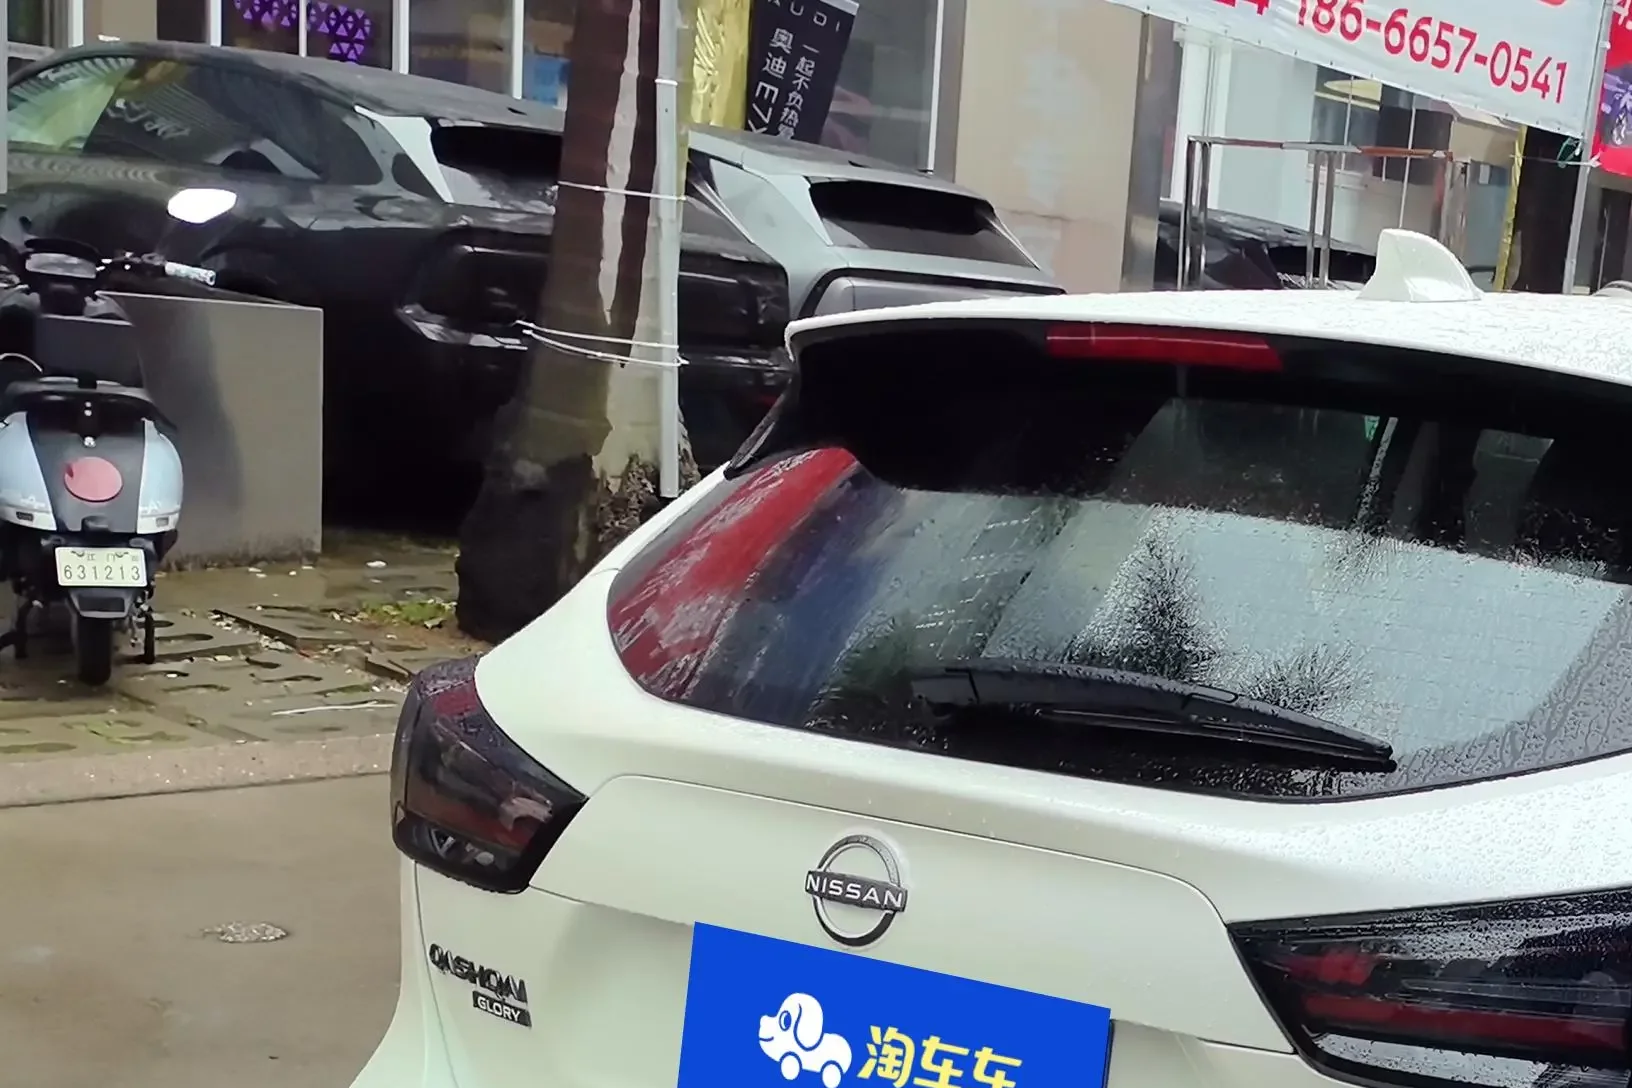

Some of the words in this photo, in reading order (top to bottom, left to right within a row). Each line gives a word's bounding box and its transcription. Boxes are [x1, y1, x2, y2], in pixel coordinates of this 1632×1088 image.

[64, 564, 141, 581] 631213
[806, 873, 904, 908] NISSAN
[476, 995, 522, 1023] GLORY
